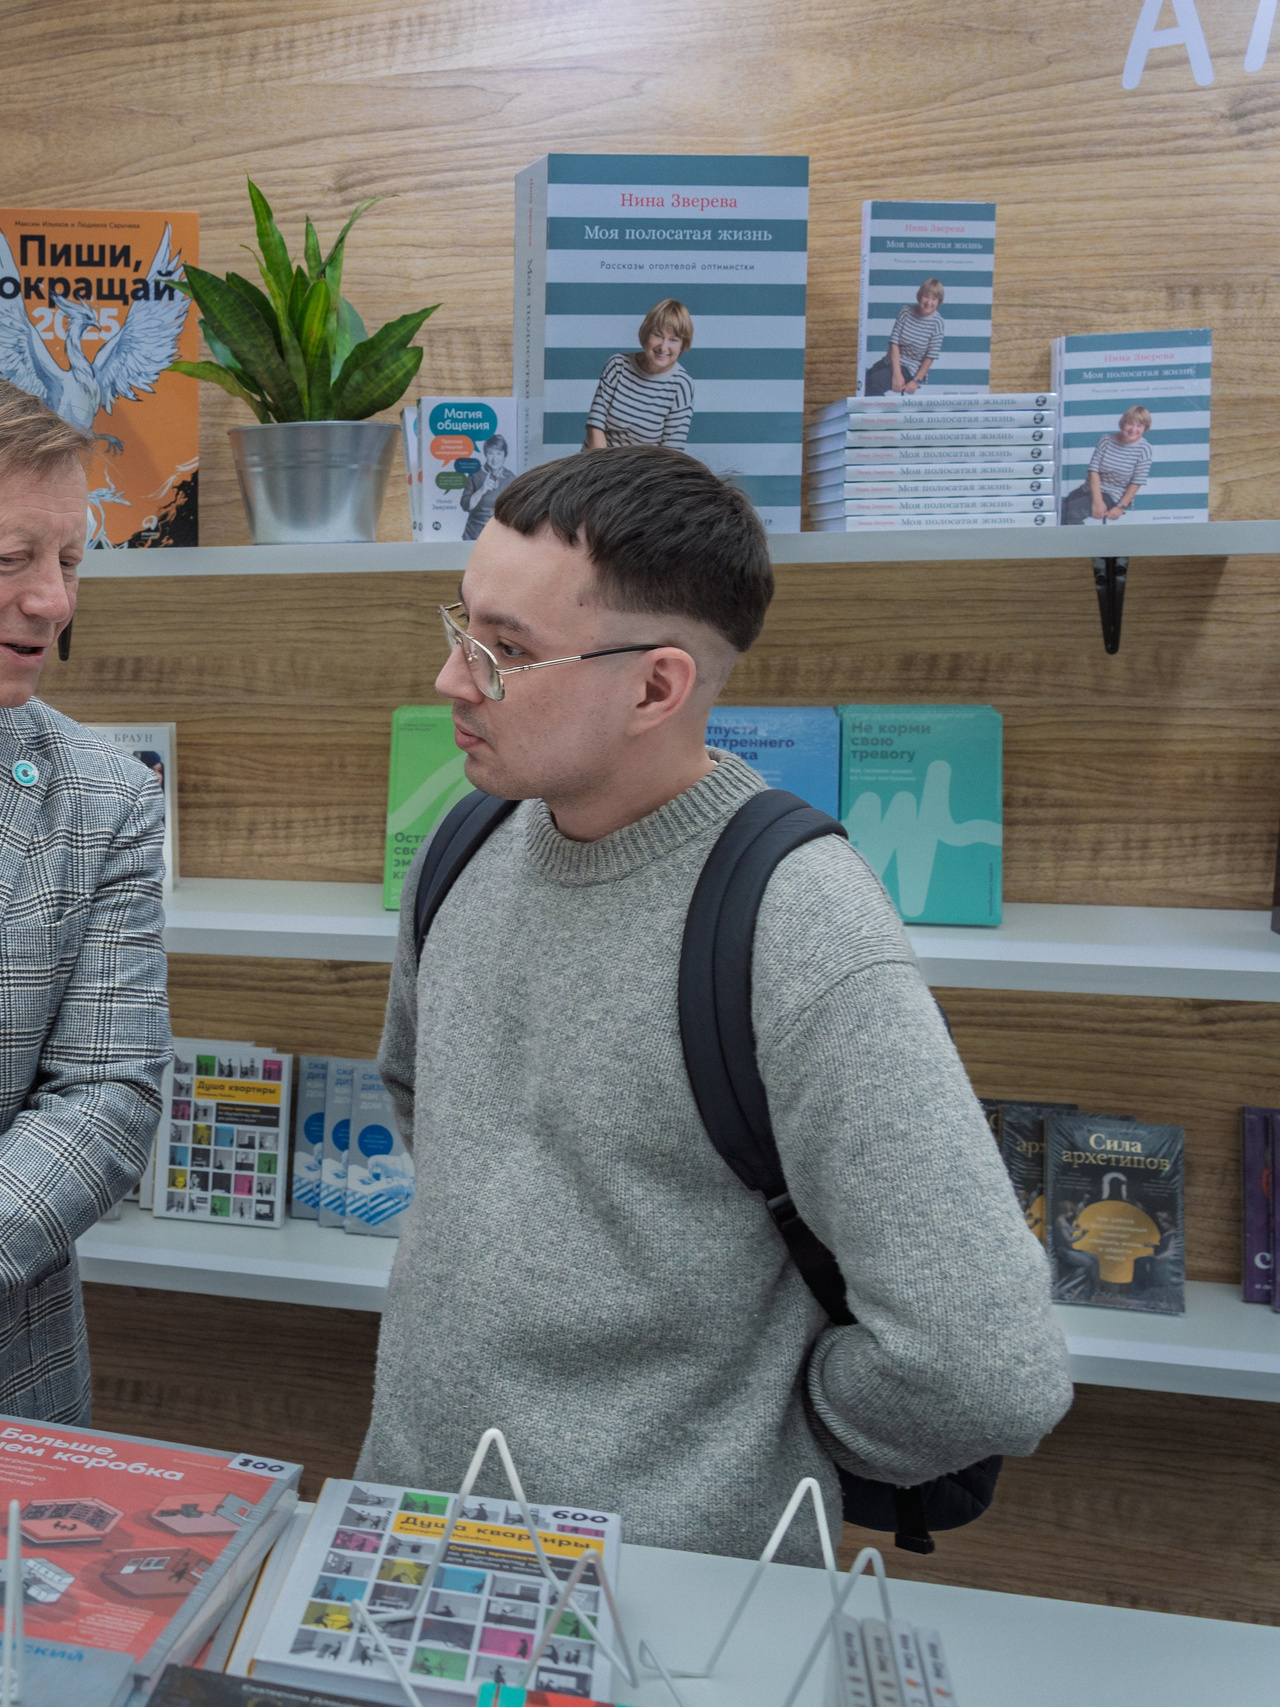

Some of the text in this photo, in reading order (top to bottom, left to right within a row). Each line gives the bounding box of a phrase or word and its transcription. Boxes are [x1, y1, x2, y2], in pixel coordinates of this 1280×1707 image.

[620, 193, 738, 212] Нина Зверева
[584, 225, 772, 242] Моя полосатая жизнь
[886, 240, 904, 248] Моя
[907, 241, 951, 249] полосатая
[20, 234, 143, 273] Пиши,
[600, 261, 755, 272] Рассказы оголтелой оптимистки
[1083, 371, 1103, 379] Моя
[1107, 370, 1159, 379] полосатая
[444, 408, 482, 419] Магия
[437, 420, 490, 431] общения
[851, 721, 931, 737] Не корми
[114, 733, 153, 742] БРАУН
[851, 737, 894, 747] свою
[850, 750, 916, 763] тревогу
[197, 1081, 277, 1096] Душа квартиры
[1089, 1133, 1142, 1154] Сила
[1061, 1150, 1171, 1171] архетипов
[0, 1427, 118, 1459] Больше,
[52, 1451, 185, 1481] коробка
[552, 1511, 609, 1524] 600
